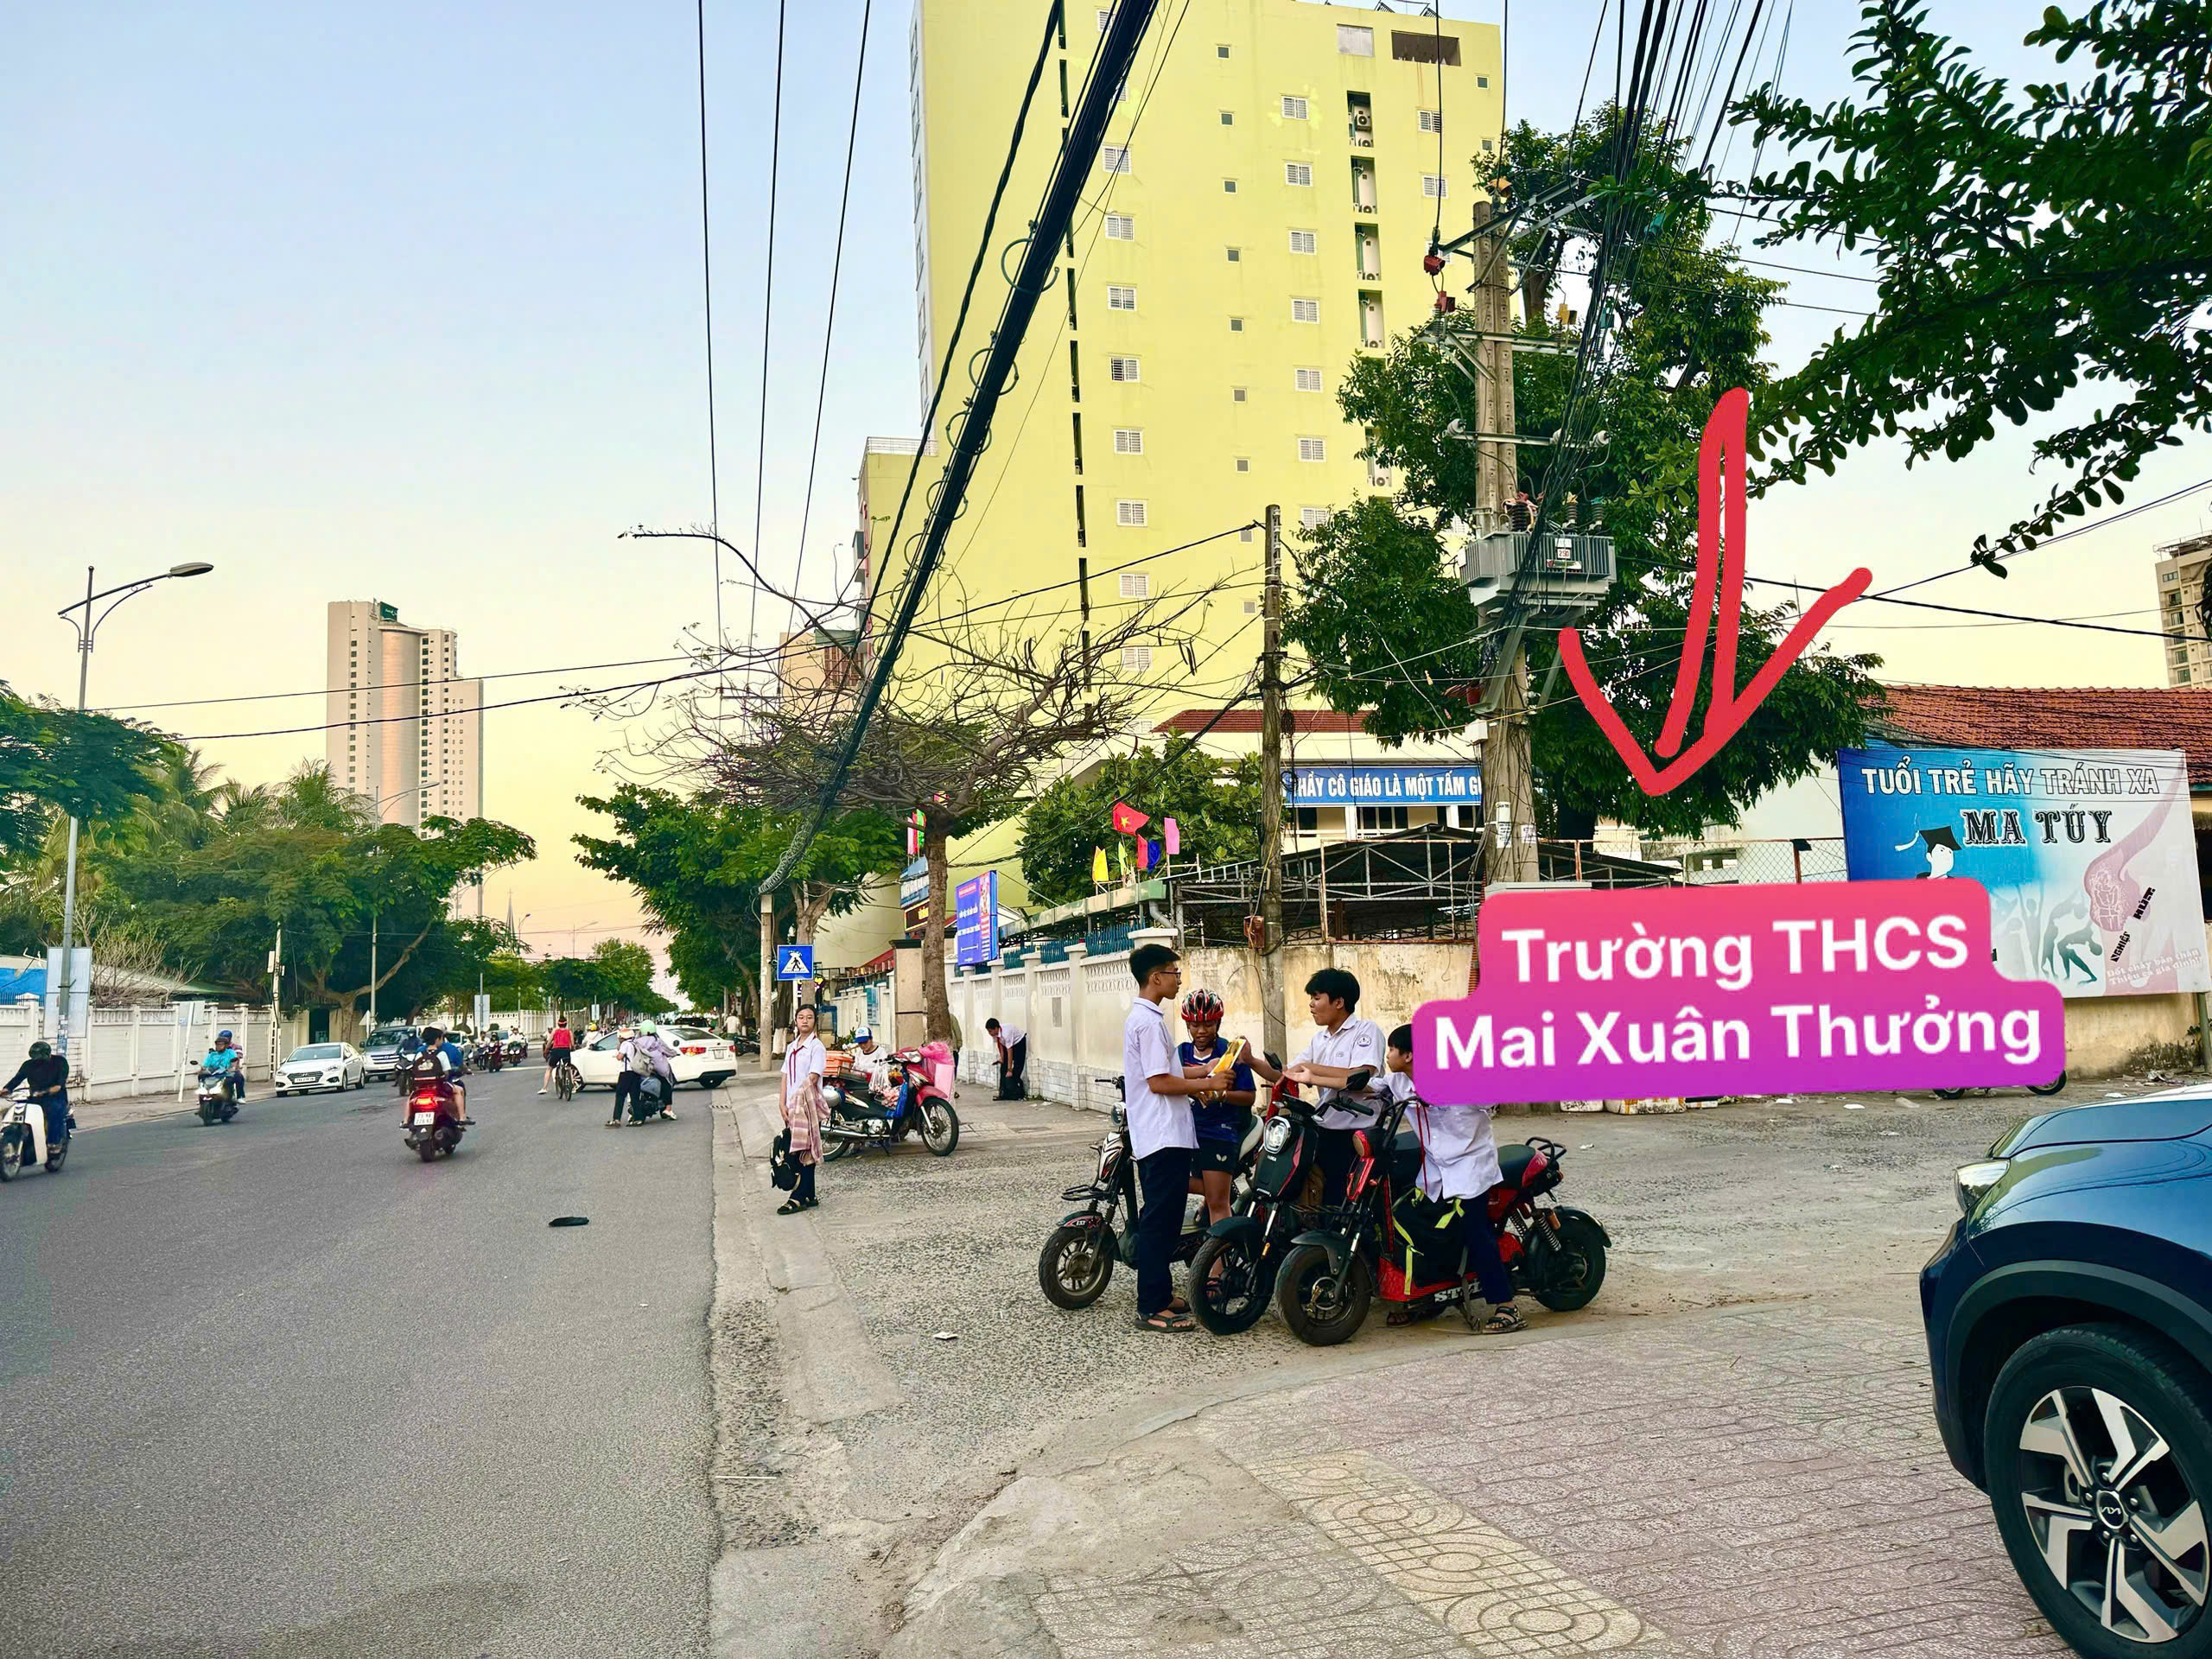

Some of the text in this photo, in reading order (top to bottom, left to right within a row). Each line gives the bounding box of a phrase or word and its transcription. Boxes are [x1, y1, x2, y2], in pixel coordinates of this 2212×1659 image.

[1327, 773, 1346, 797] CÔ
[1350, 773, 1382, 797] GIÁO
[1384, 772, 1402, 797] LÀ
[1404, 772, 1433, 801] MỘT
[1436, 770, 1466, 796] TẤM
[1861, 754, 2160, 795] TUỔI TRẺ HÃY TRÁNH XA
[1961, 803, 2113, 845] MA TÚY
